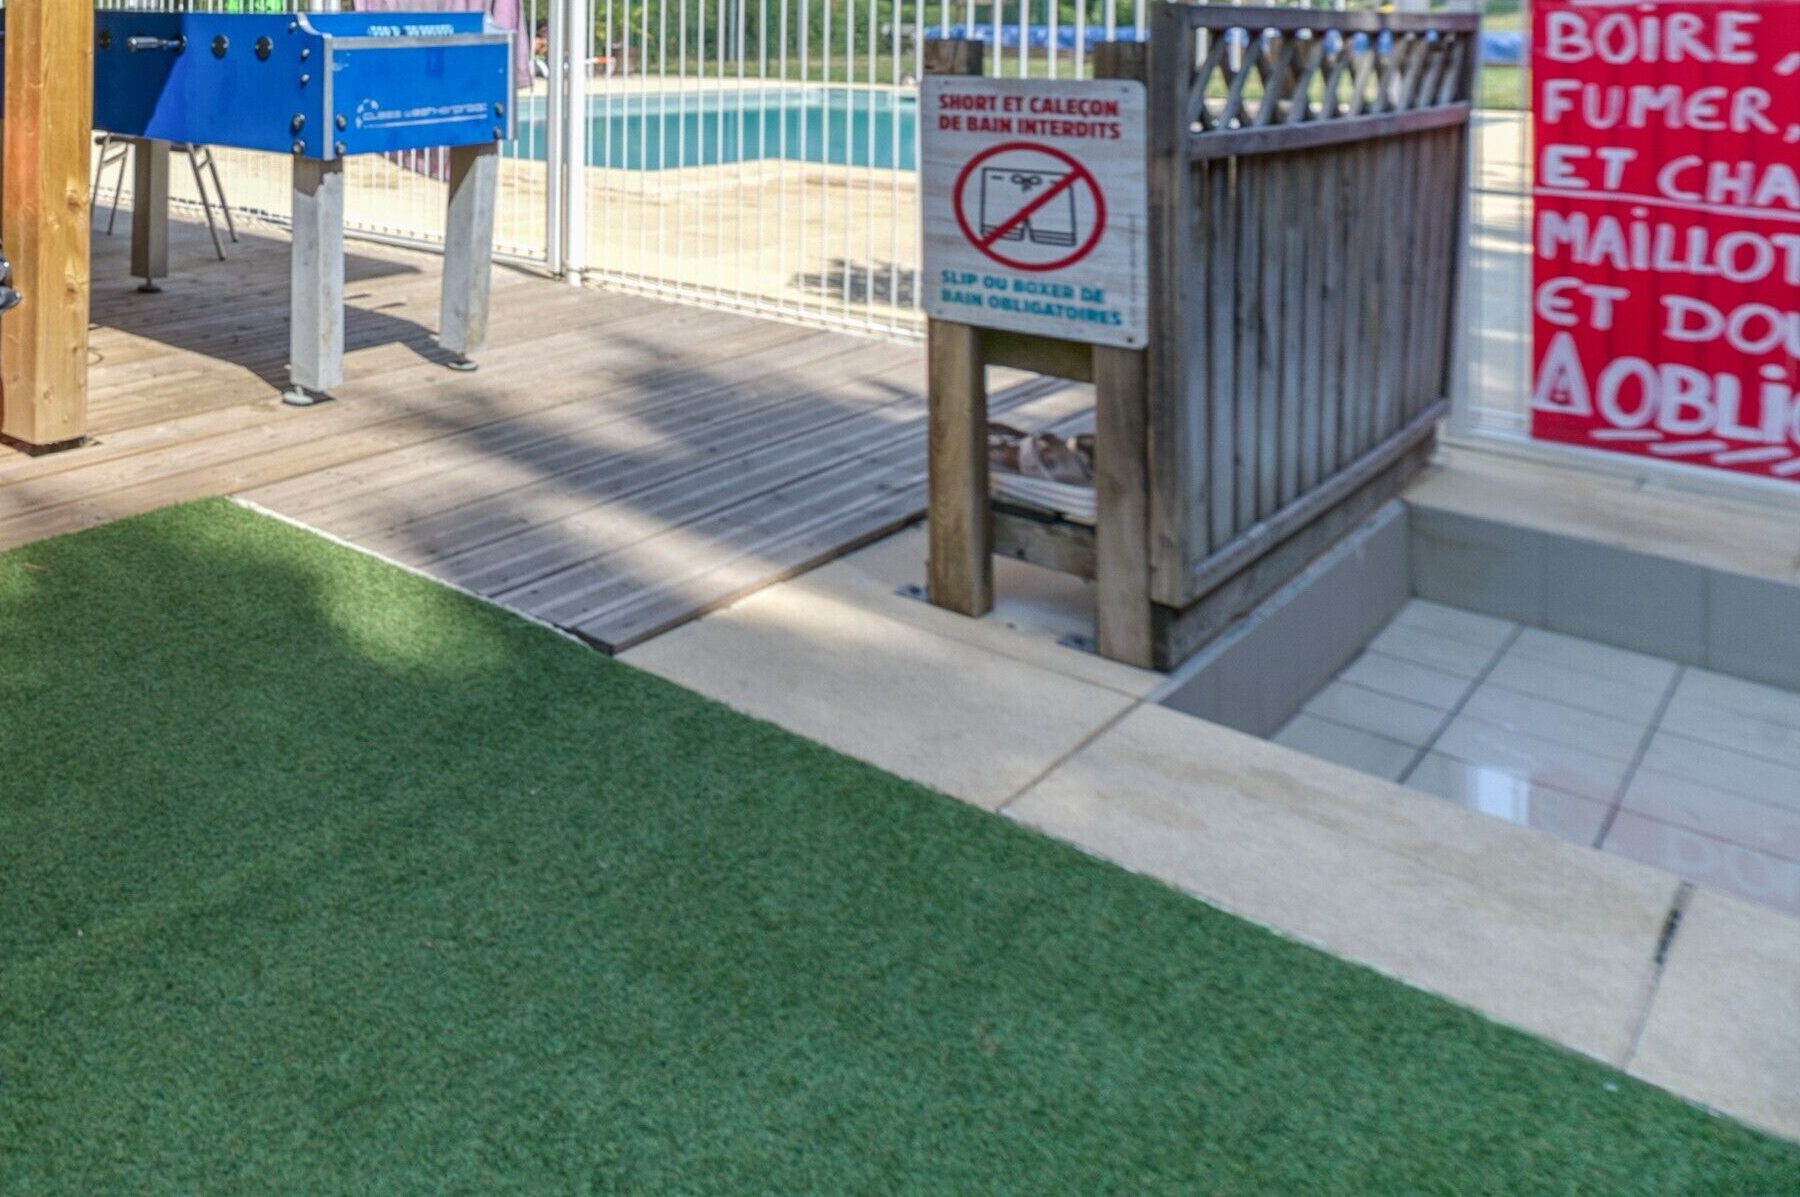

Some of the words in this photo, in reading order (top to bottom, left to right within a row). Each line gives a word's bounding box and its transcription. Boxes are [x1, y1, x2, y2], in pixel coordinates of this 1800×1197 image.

[938, 93, 998, 113] SHORT
[1003, 96, 1024, 113] ET
[1029, 97, 1120, 118] CALEÇON
[938, 114, 963, 132] DE
[967, 116, 1012, 135] BAIN
[1017, 118, 1121, 141] INTERDITS
[1539, 143, 1638, 190] ET
[941, 269, 978, 287] SLIP
[983, 273, 1008, 291] OU
[1012, 276, 1076, 300] BOXER
[1080, 285, 1106, 304] DE
[1535, 276, 1632, 331] ET
[941, 288, 983, 308] BAIN
[988, 295, 1123, 328] OBLIGATOIRES
